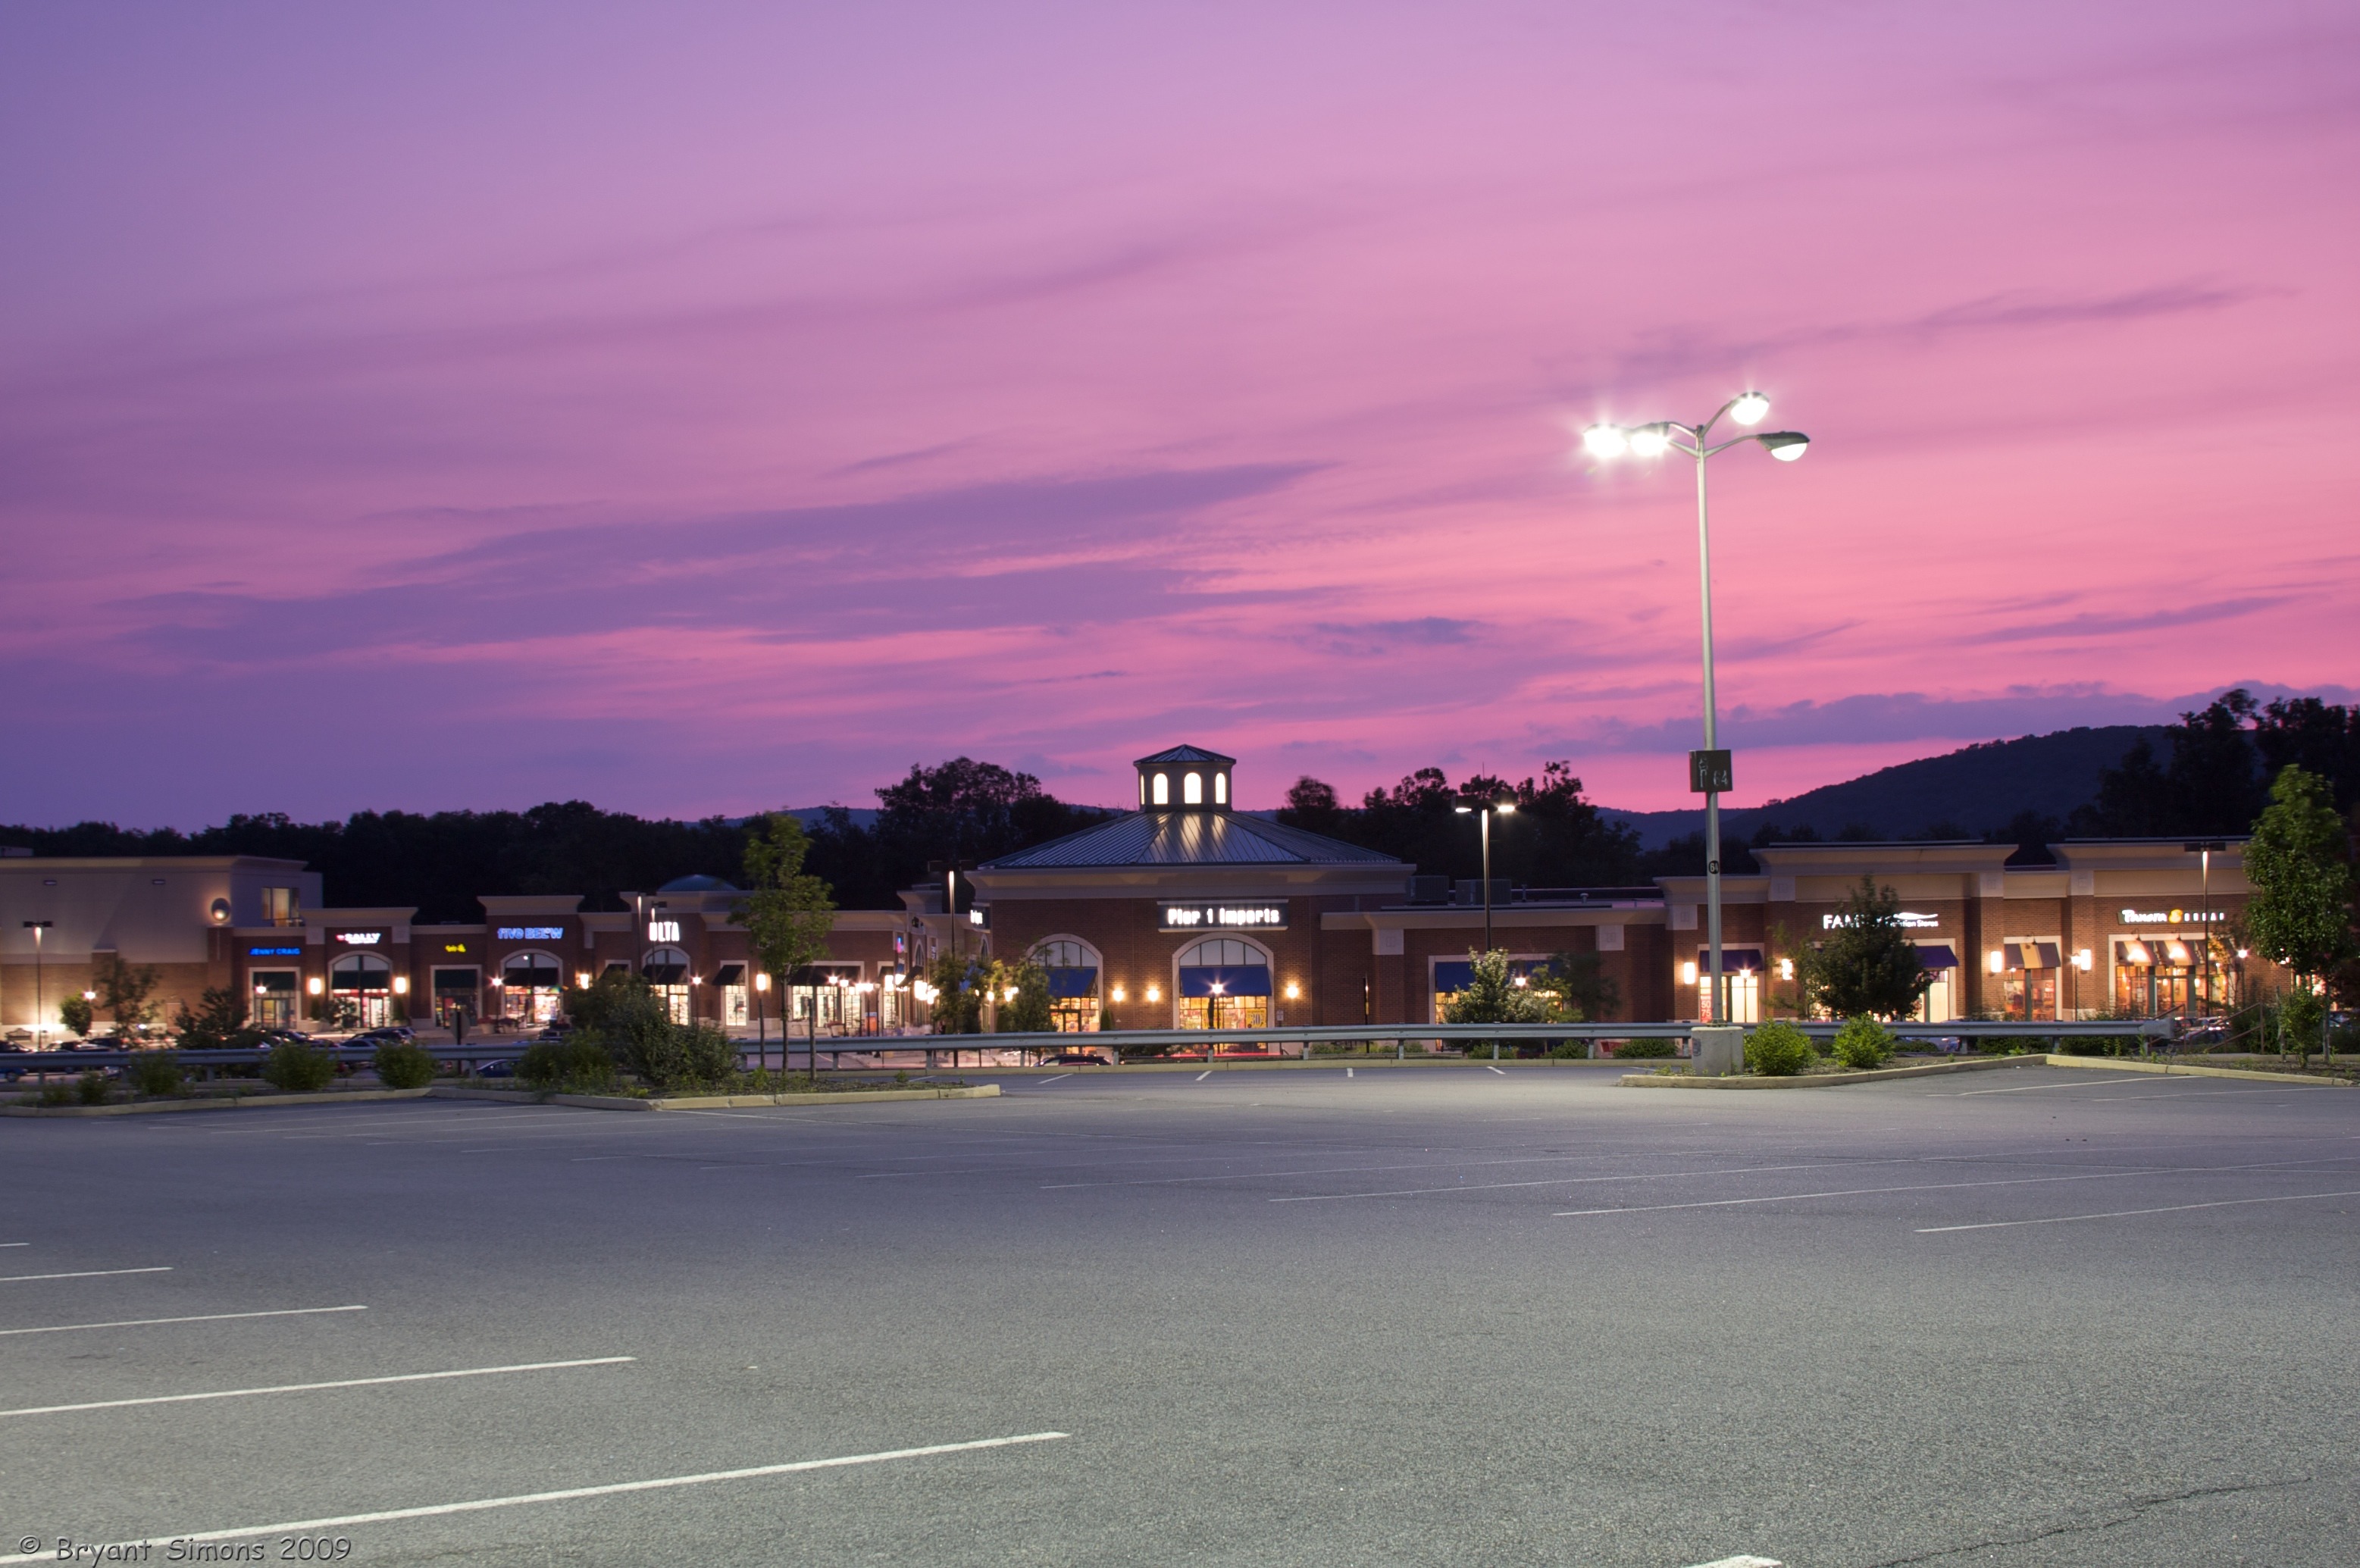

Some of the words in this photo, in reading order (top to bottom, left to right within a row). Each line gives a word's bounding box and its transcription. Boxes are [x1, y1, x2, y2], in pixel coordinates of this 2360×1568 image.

[1168, 908, 1200, 925] Pier
[1207, 908, 1213, 925] 1
[2121, 909, 2168, 923] Panera
[497, 927, 524, 940] five
[649, 921, 680, 942] ULTA
